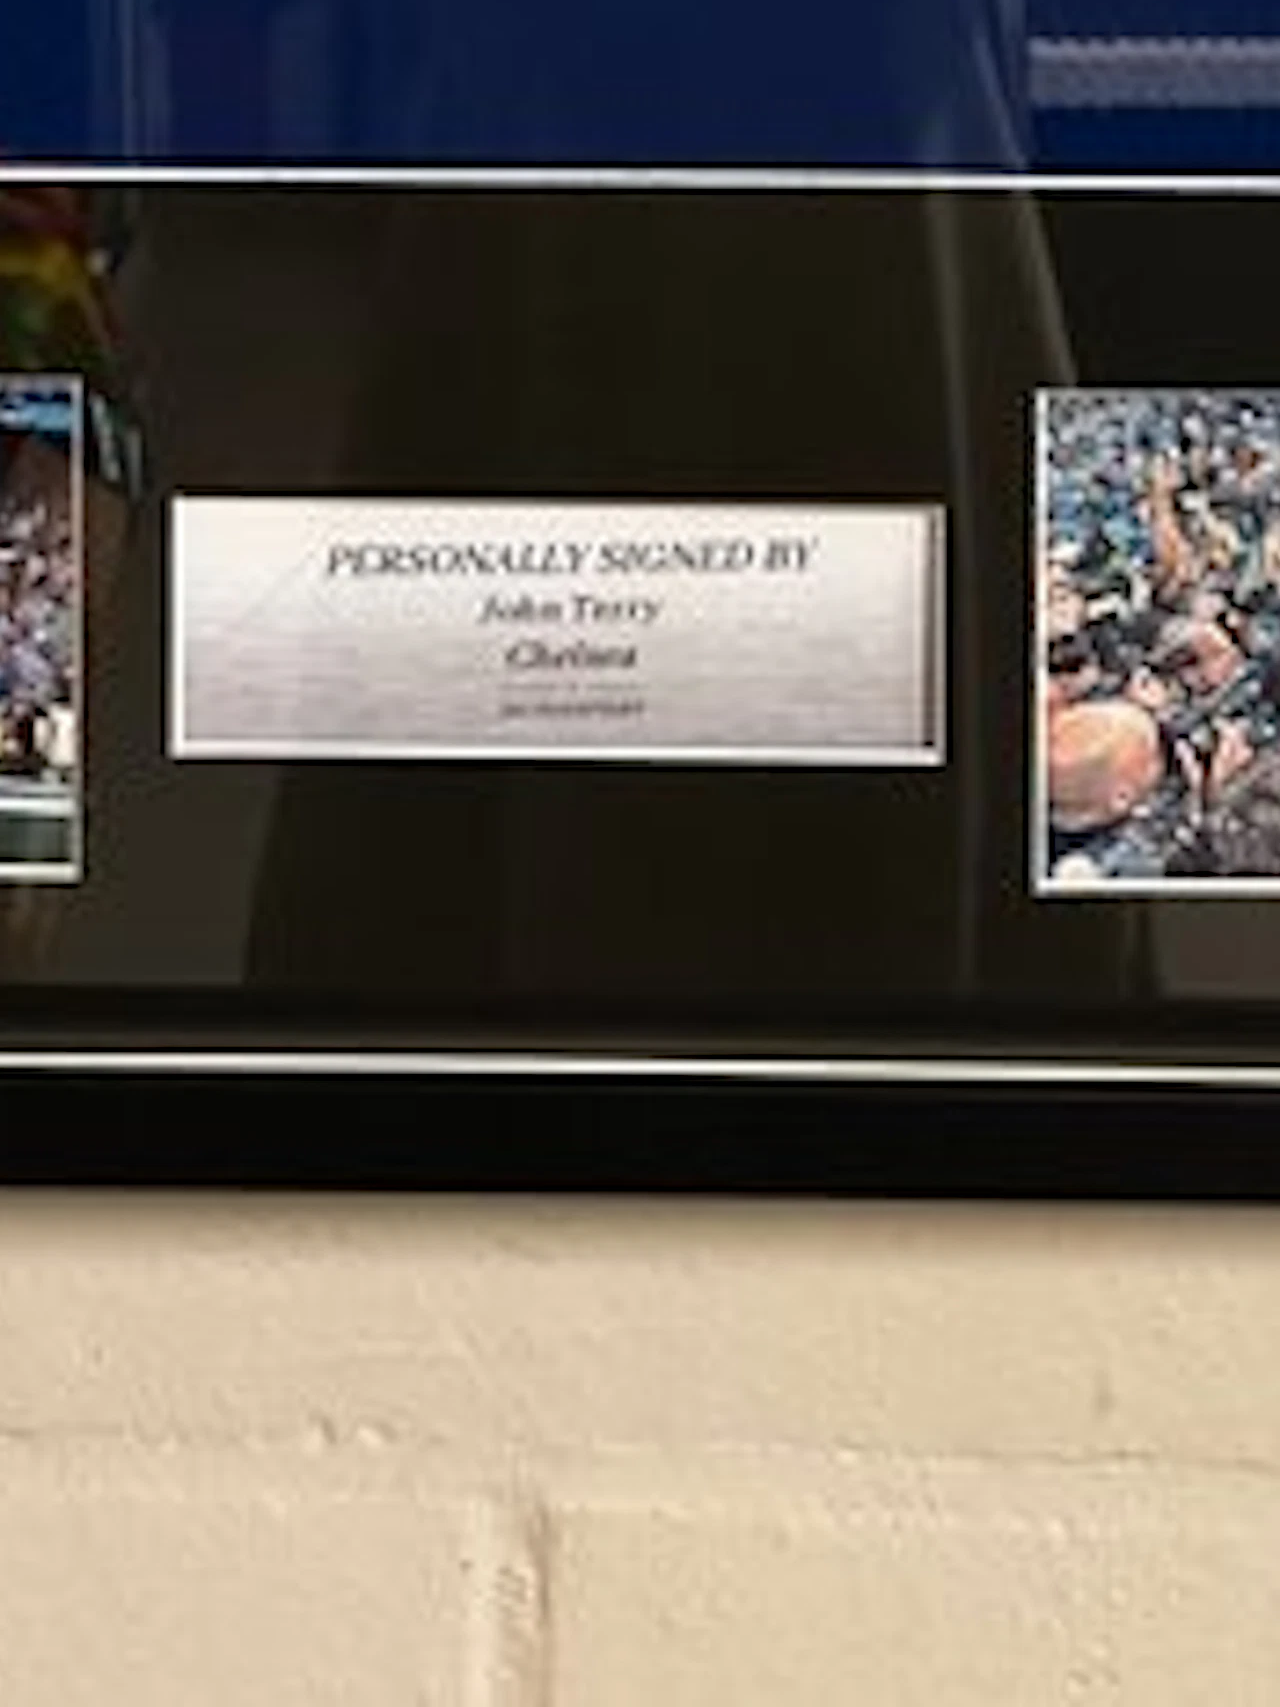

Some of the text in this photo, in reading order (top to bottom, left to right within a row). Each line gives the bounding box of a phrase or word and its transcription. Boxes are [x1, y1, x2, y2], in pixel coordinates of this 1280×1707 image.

[324, 534, 819, 576] PERSONALLY SIGNED BY
[476, 595, 662, 625] John Terry
